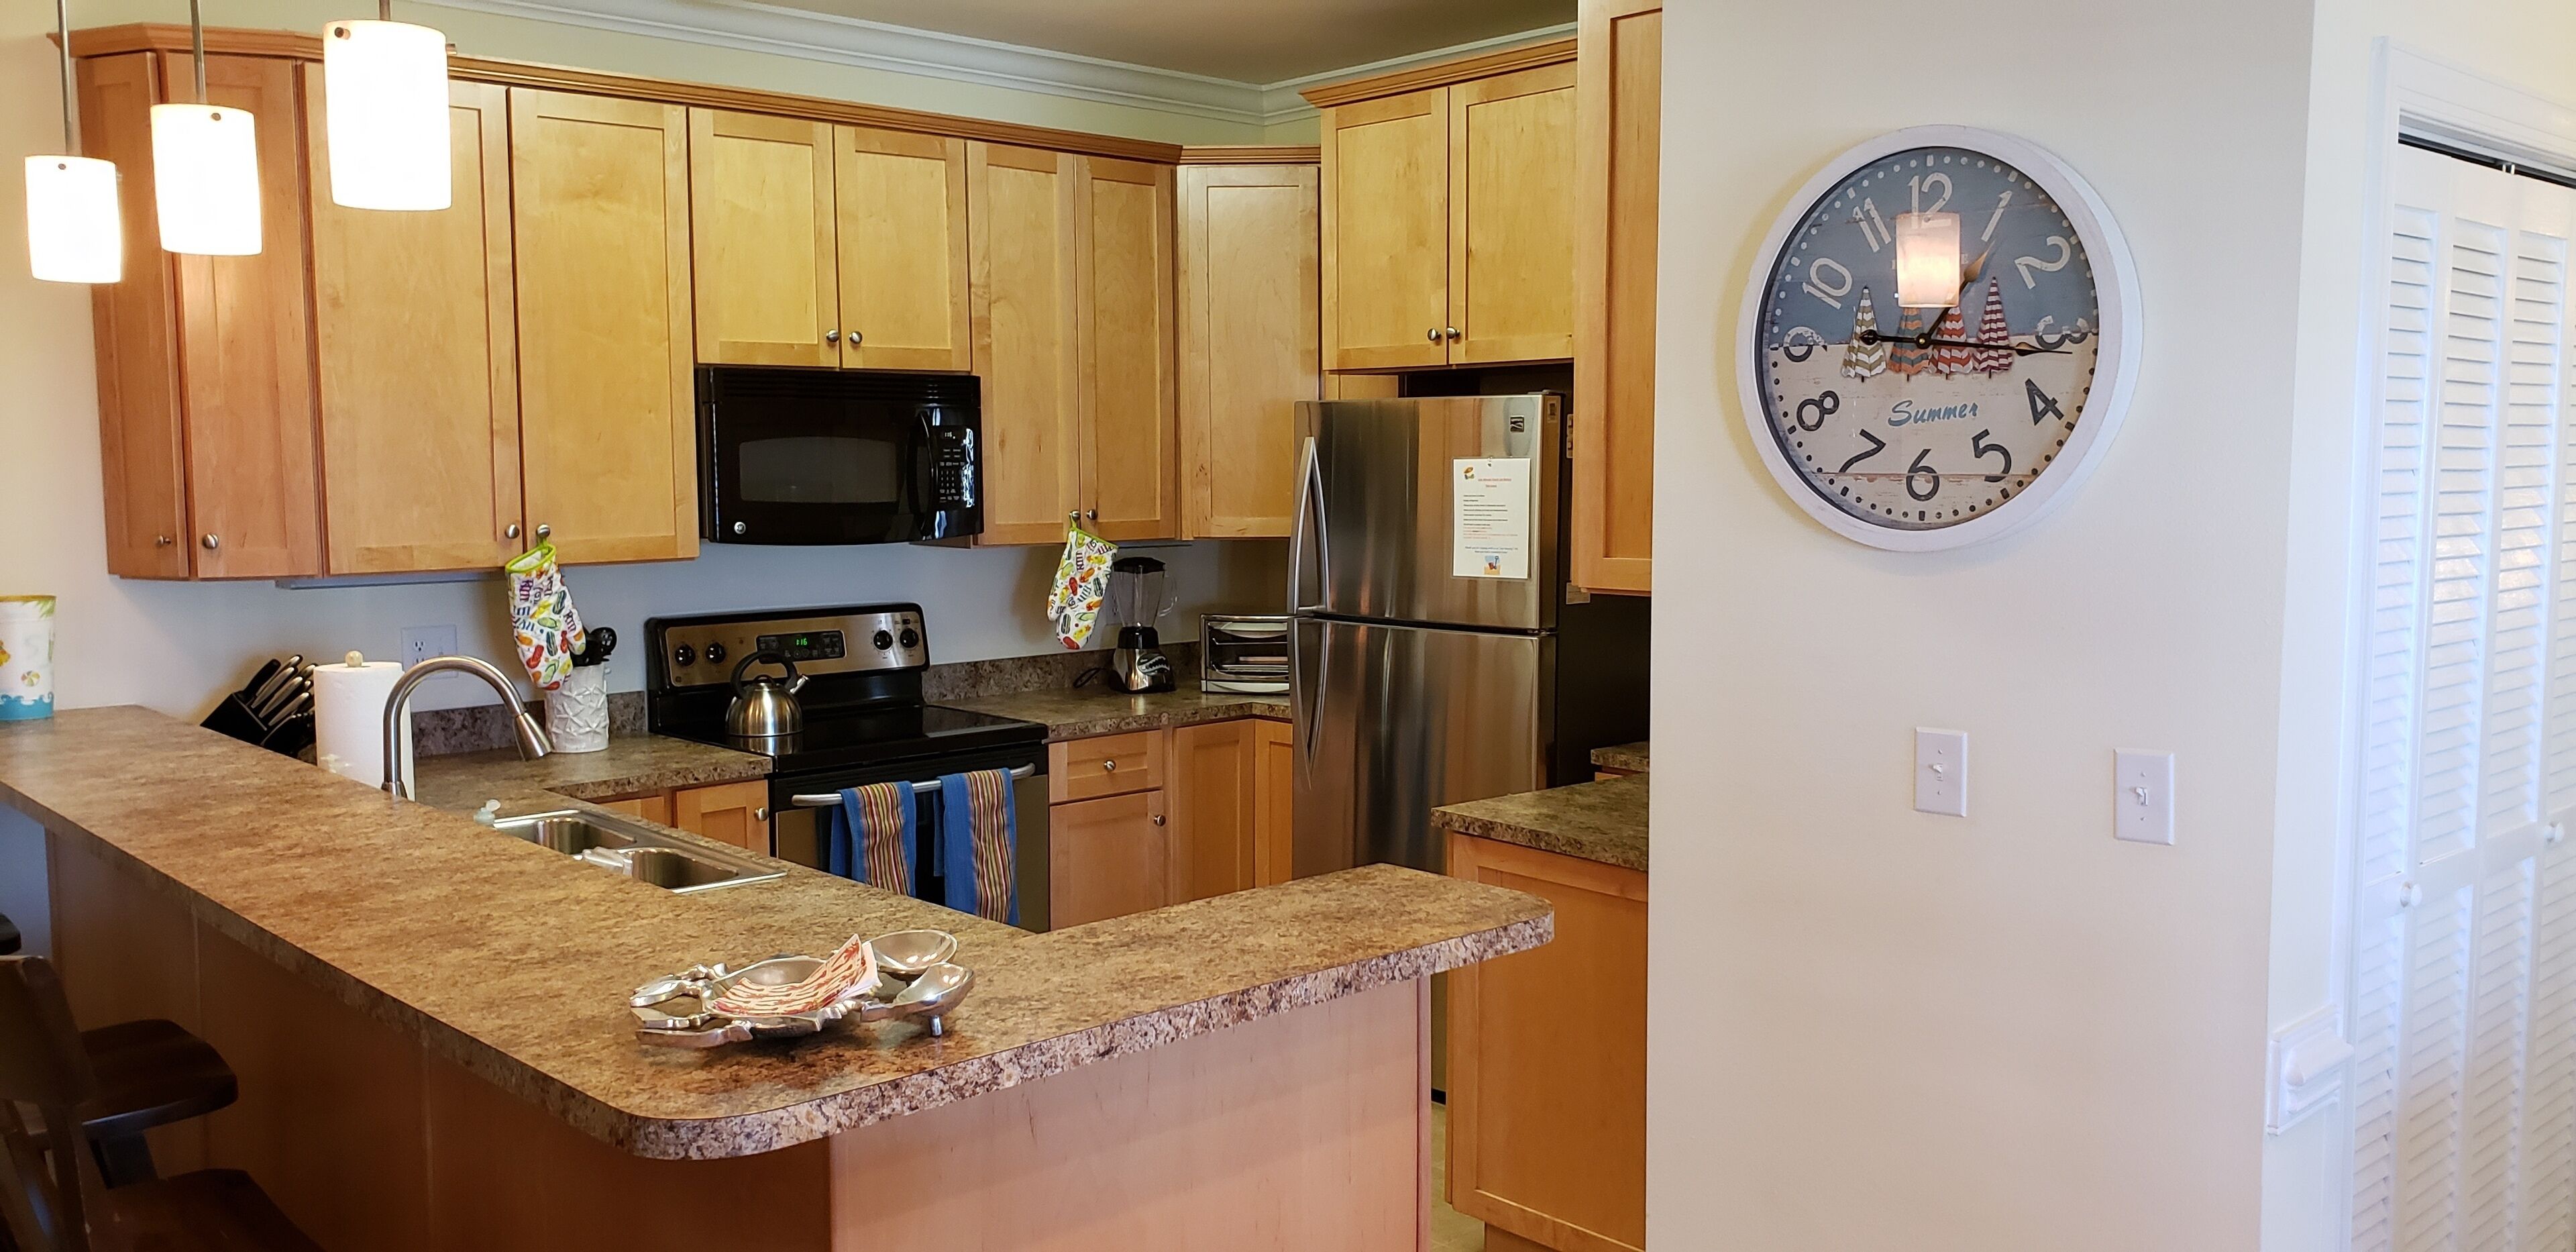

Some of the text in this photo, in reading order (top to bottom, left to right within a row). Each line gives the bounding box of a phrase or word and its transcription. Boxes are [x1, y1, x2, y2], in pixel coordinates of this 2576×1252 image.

[1854, 197, 1892, 253] 11
[1908, 172, 1953, 229] 12
[1981, 190, 2013, 242] 1
[1803, 258, 1854, 310] 10
[2014, 236, 2072, 289] 2
[1784, 326, 1828, 362] 9
[2035, 315, 2088, 350] 3
[1796, 390, 1840, 432] 8
[1888, 399, 1978, 427] Summer
[2025, 378, 2065, 426] 4
[1838, 429, 1886, 474] 7
[1906, 448, 1940, 502] 6
[1972, 429, 2012, 482] 5
